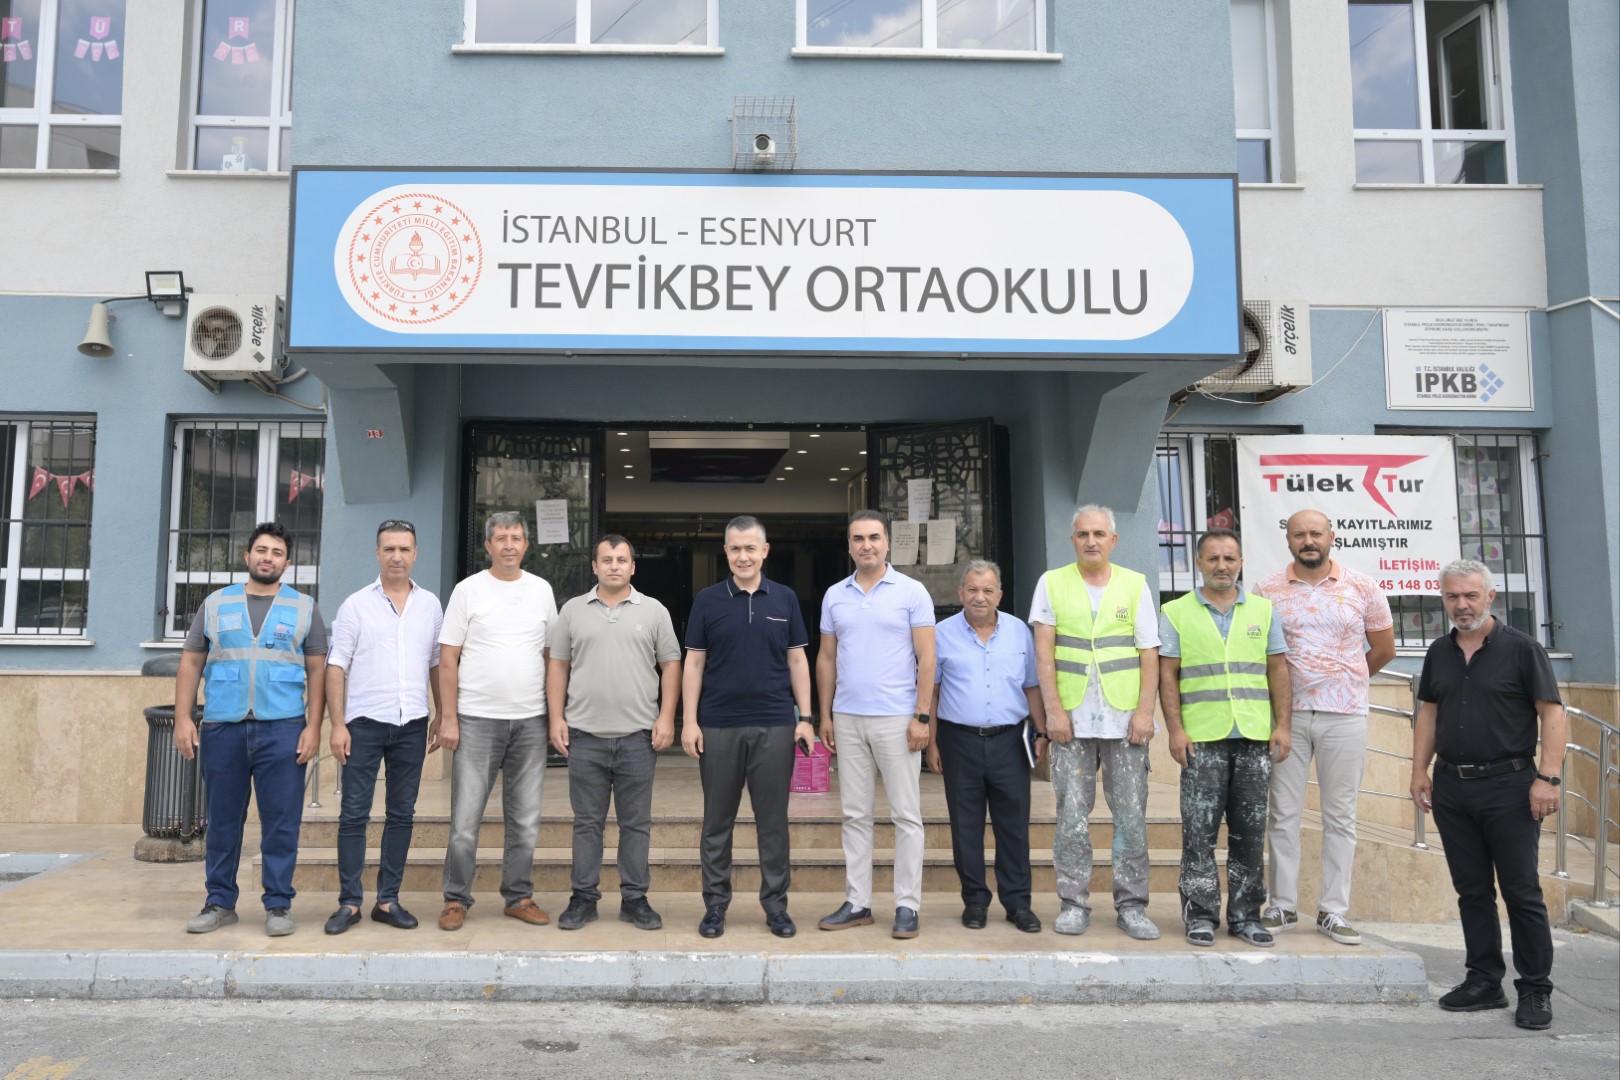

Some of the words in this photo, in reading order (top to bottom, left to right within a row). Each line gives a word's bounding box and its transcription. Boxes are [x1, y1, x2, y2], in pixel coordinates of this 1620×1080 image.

[8, 20, 16, 32] T
[95, 19, 105, 34] Ü
[235, 21, 244, 31] R
[414, 216, 438, 229] MİLLİ
[502, 209, 667, 245] İSTANBUL
[700, 217, 876, 247] ESENYURT
[374, 217, 411, 268] CUMHURİYETİ
[439, 227, 458, 256] EĞİTİM
[376, 269, 405, 298] TÜRKİYE
[424, 258, 458, 298] BAKANLIĞI
[498, 254, 791, 312] TEVFİKBEY
[806, 264, 1148, 316] ORTAOKULU
[251, 304, 264, 347] arçelik
[1280, 304, 1299, 355] arçelik
[1263, 474, 1354, 492] Tülek
[1382, 474, 1424, 493] Tur
[1337, 519, 1433, 530] KAYITLARIMIZ
[1331, 537, 1408, 550] ŞLAMIŞTIR
[1379, 557, 1440, 573] İLETİŞİM:
[1398, 579, 1421, 590] 148
[1425, 579, 1440, 590] 03
